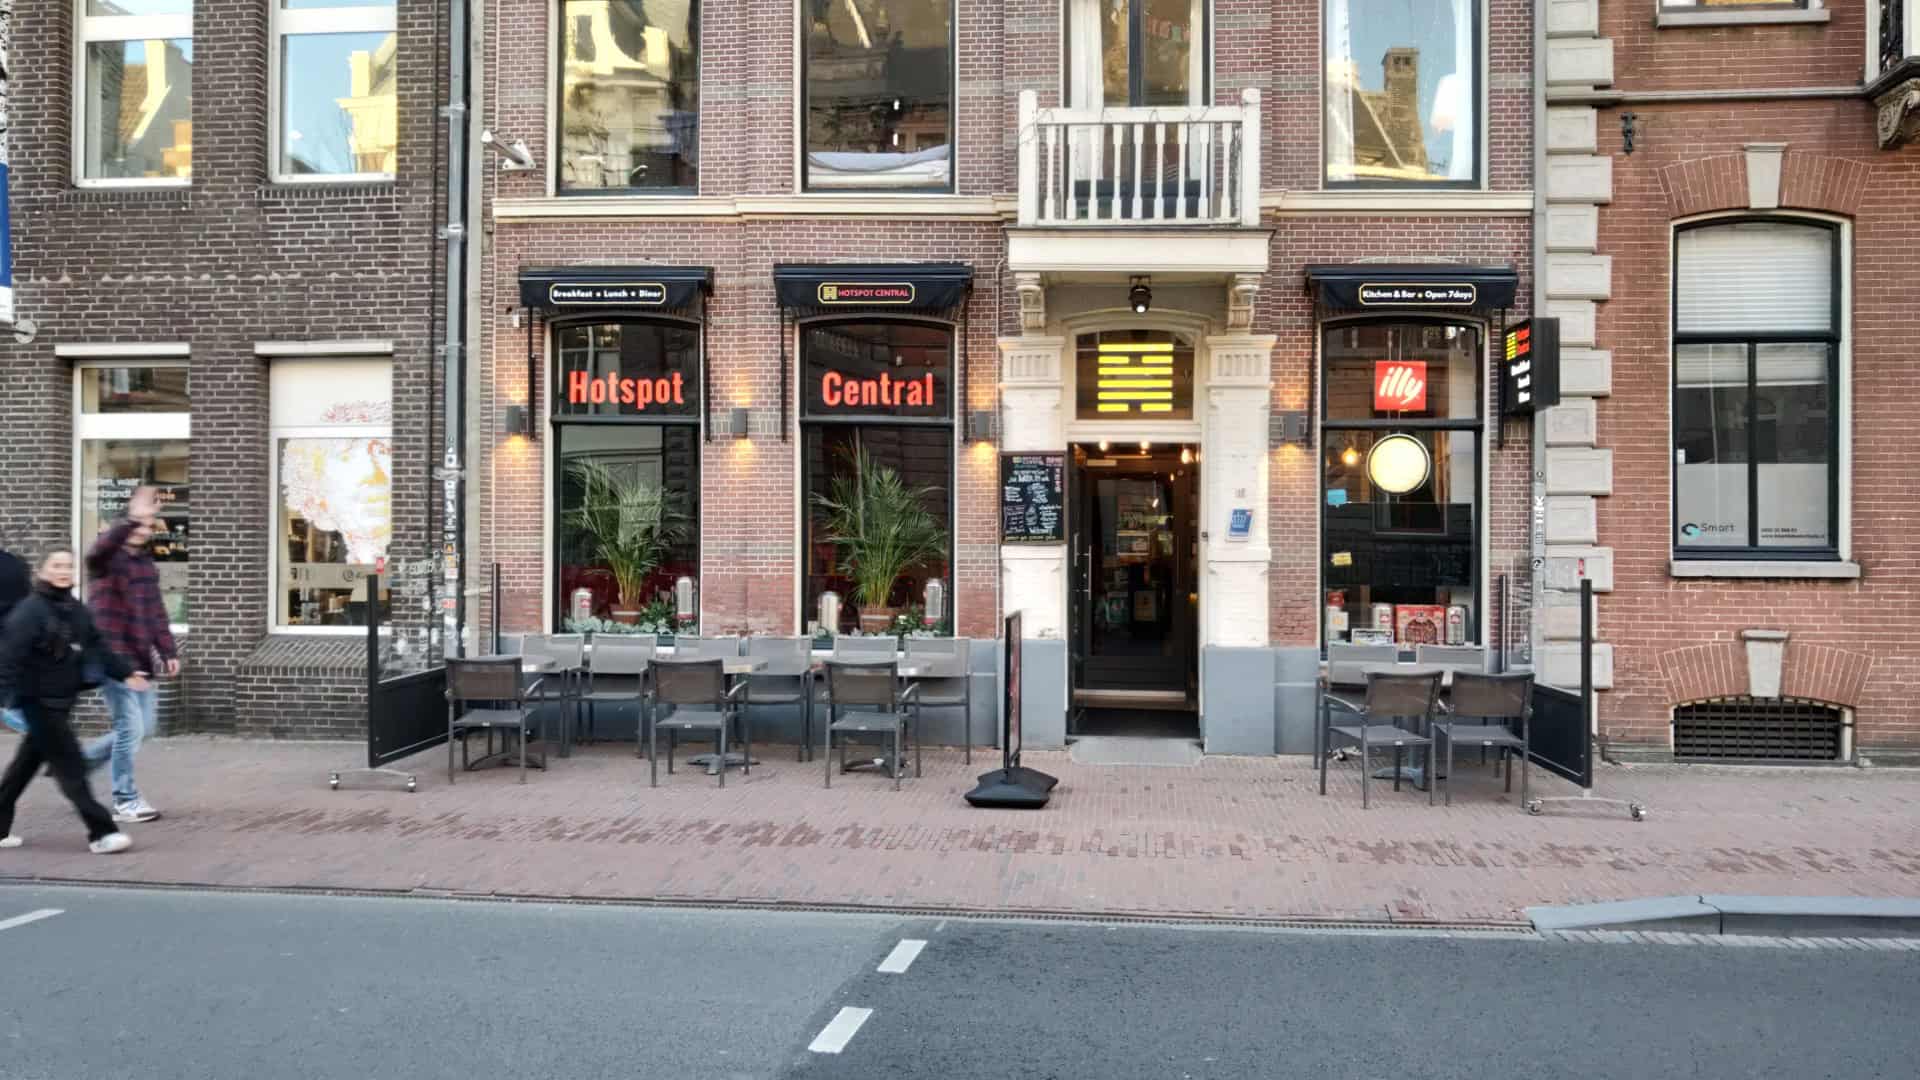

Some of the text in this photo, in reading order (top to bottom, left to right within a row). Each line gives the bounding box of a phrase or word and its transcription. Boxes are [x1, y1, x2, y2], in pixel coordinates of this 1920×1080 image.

[552, 289, 593, 298] Breakfast
[603, 289, 628, 298] Lunch
[838, 289, 910, 297] HOTSPOT CENTRAL
[1362, 289, 1393, 298] Kitchen
[1394, 289, 1401, 298] &
[1401, 289, 1416, 298] Bar
[1425, 290, 1447, 300] Open
[568, 370, 685, 410] Hotspot
[822, 370, 934, 406] Central
[1379, 366, 1423, 405] illy
[1701, 523, 1735, 533] Smart
